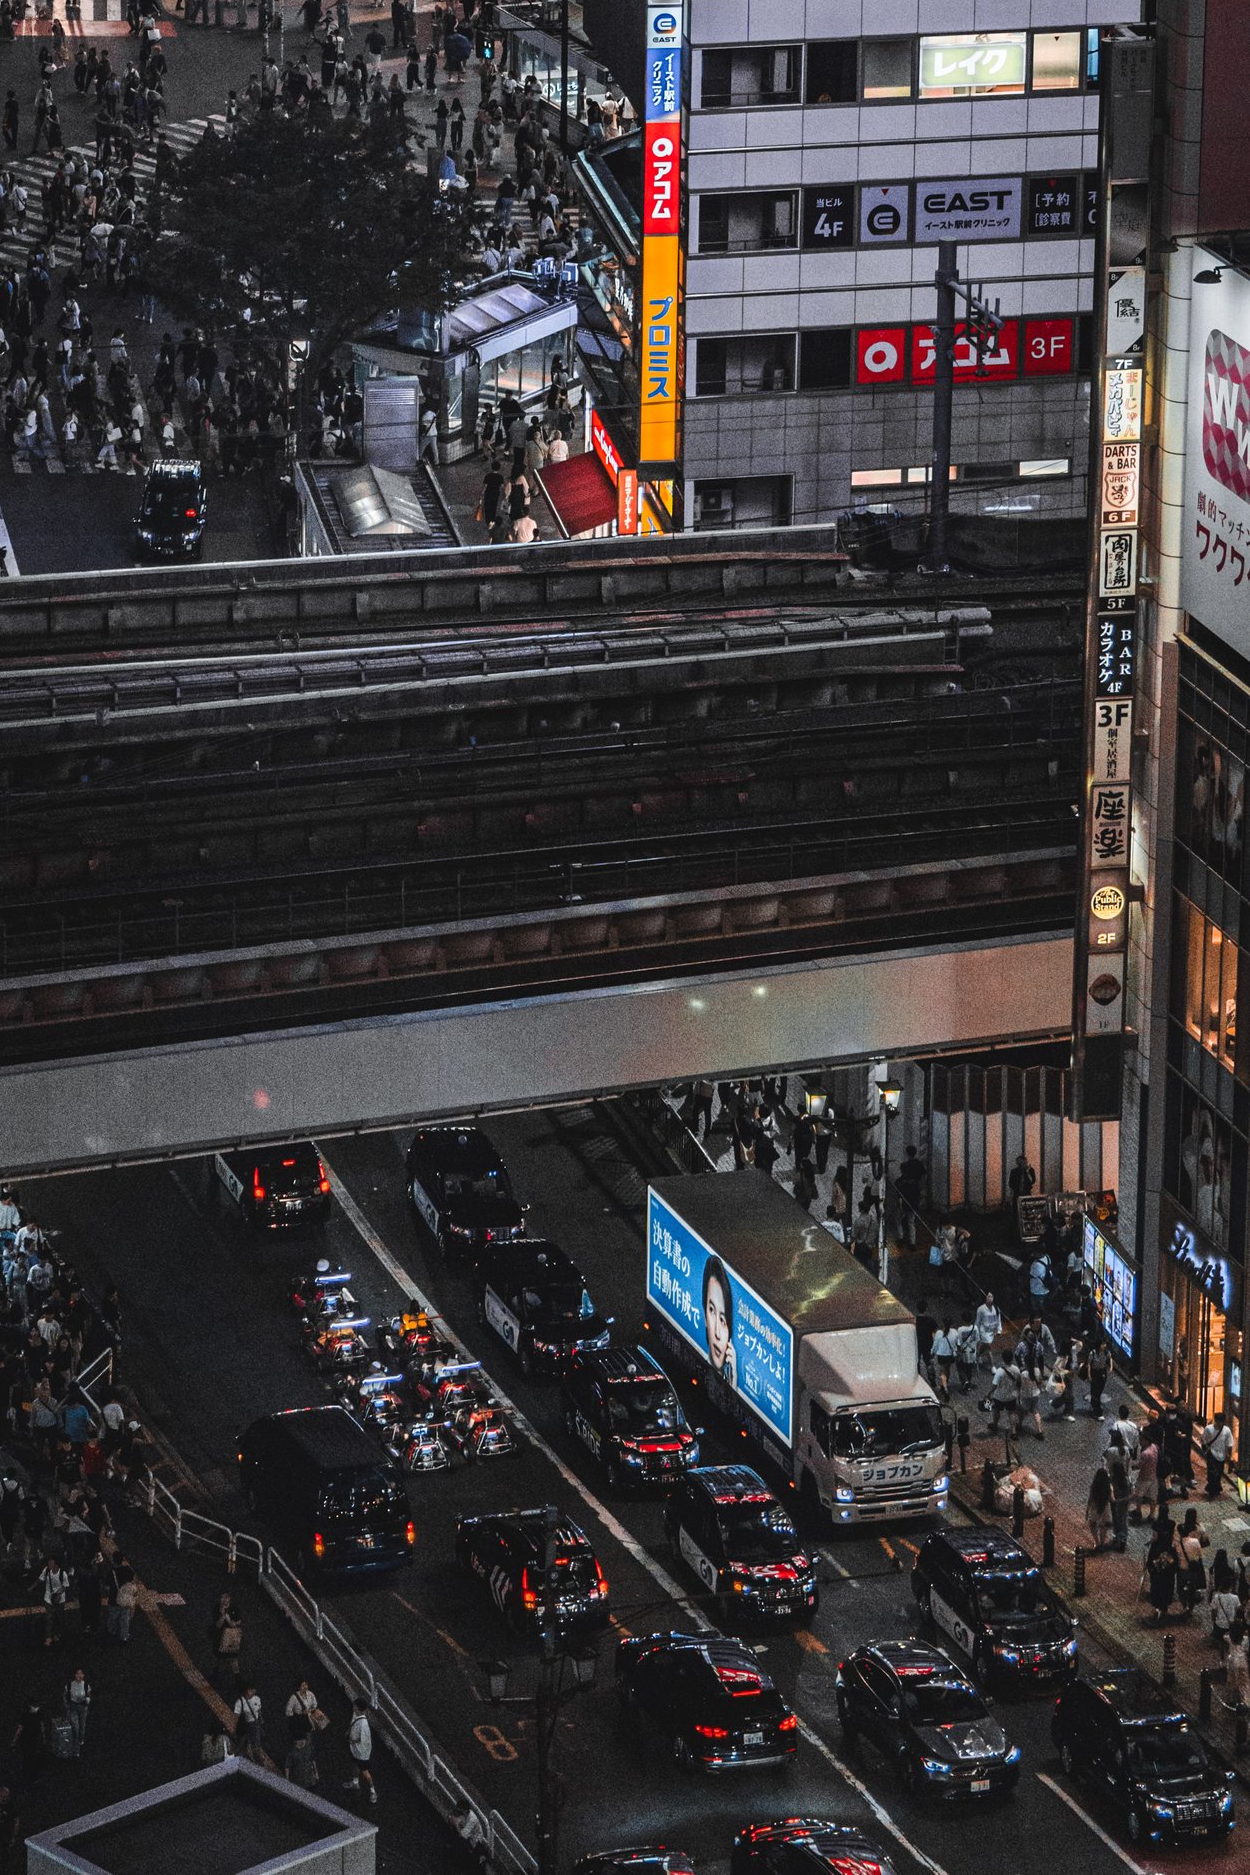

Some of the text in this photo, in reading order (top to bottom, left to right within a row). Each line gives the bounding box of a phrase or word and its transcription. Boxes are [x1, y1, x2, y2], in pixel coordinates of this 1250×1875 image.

[934, 49, 1007, 78] レイク
[651, 161, 673, 219] アコム
[816, 197, 843, 208] 当ビル
[923, 190, 1012, 213] EAST
[814, 213, 843, 237] 4F
[647, 296, 674, 399] プロミス
[1030, 336, 1066, 359] 3F
[1115, 359, 1133, 370] 7F
[1105, 445, 1137, 460] DARTS
[1117, 457, 1137, 470] BAR
[1108, 512, 1131, 522] 6F
[1195, 520, 1250, 587] ワクワ
[1107, 597, 1126, 609] 5F
[1099, 622, 1115, 683] カラオケ
[1120, 629, 1132, 676] BAR
[1107, 682, 1122, 694] 4F
[1097, 704, 1130, 726] 3F
[1106, 726, 1117, 779] 個室居酒屋
[1095, 896, 1121, 905] Public
[1095, 903, 1120, 911] Stand
[1097, 933, 1116, 944] 2F
[653, 1222, 690, 1278] 決算書の
[653, 1261, 701, 1330] 自動作成で
[863, 1463, 923, 1481] ジョブカン
